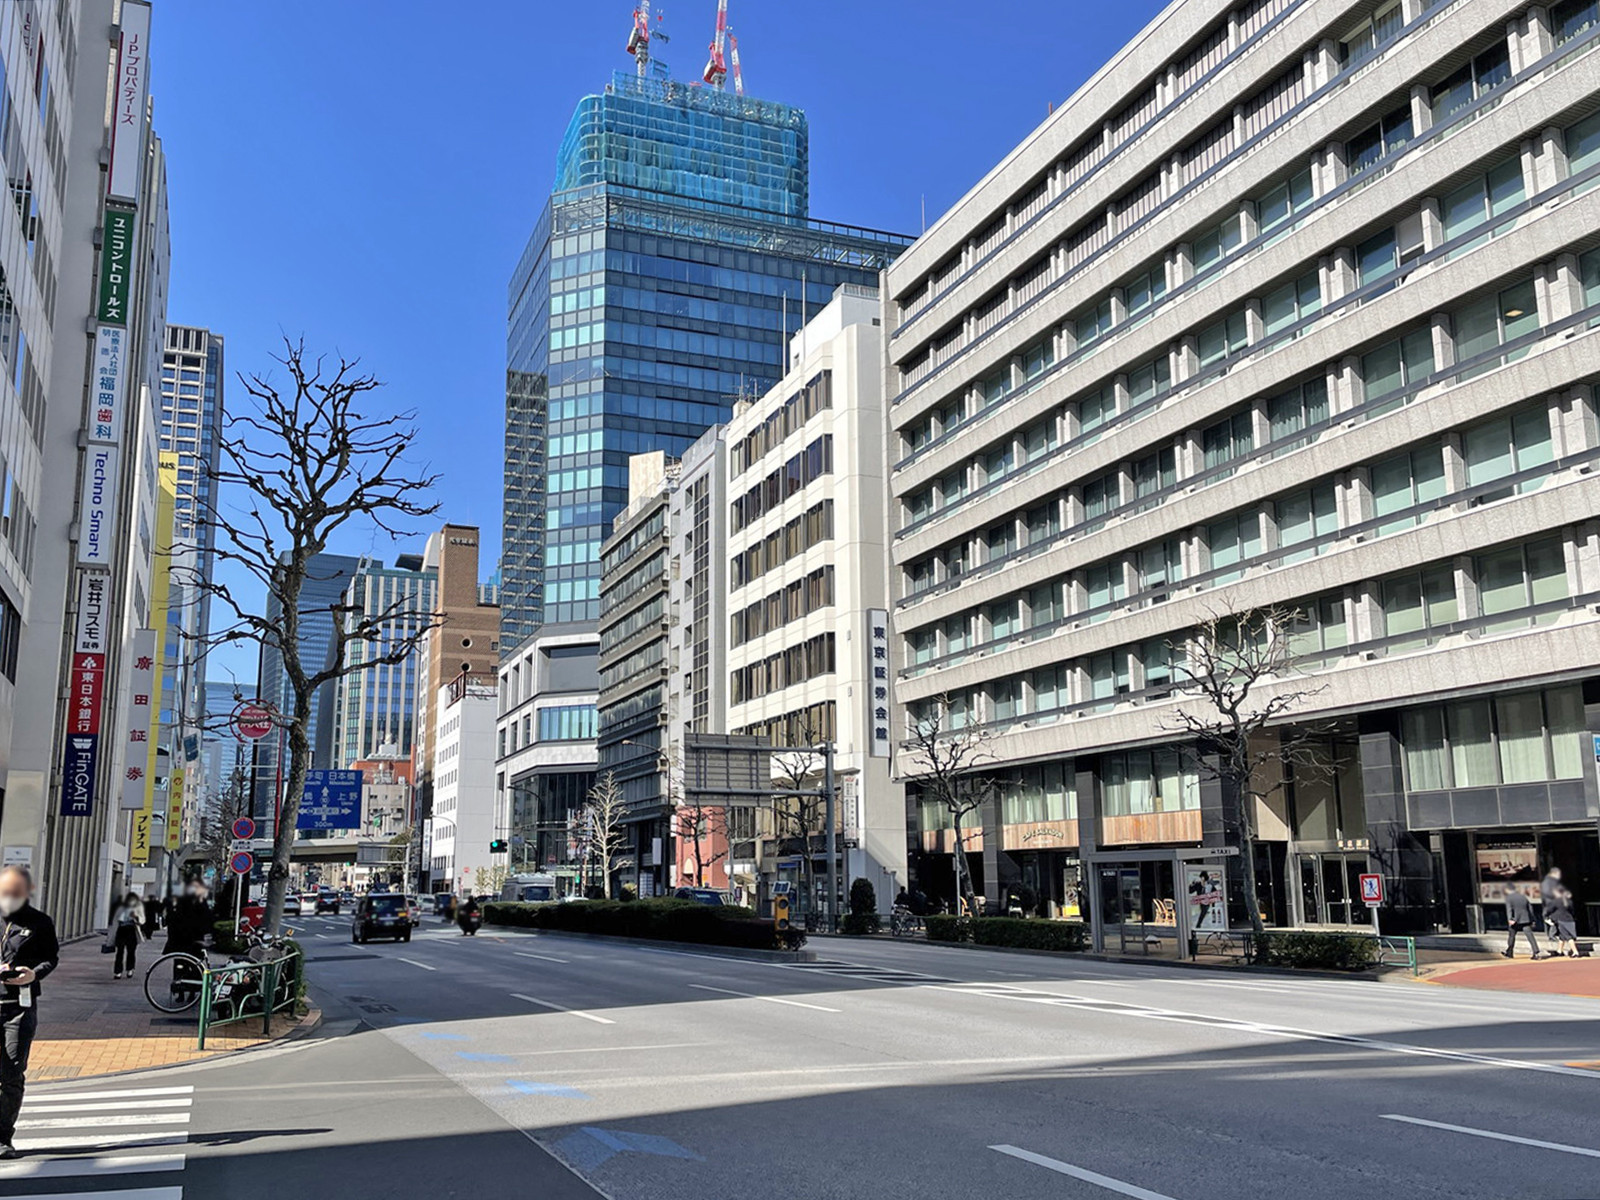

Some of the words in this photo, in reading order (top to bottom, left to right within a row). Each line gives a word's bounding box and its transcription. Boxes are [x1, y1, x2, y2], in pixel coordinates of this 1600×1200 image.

[121, 33, 140, 126] JPプロパティーズ
[95, 377, 116, 440] 福岡歯科
[92, 451, 109, 505] Techno
[87, 509, 104, 558] Smart
[85, 578, 104, 640] 岩井コスモ
[82, 641, 100, 650] 証券
[77, 672, 94, 733] 東日本銀行
[872, 626, 888, 741] 東京証券会館
[125, 655, 154, 781] 廣田証券
[72, 752, 92, 811] FinGATE
[328, 771, 356, 781] 日本橋
[337, 791, 358, 801] 上野
[135, 815, 149, 850] プレナス
